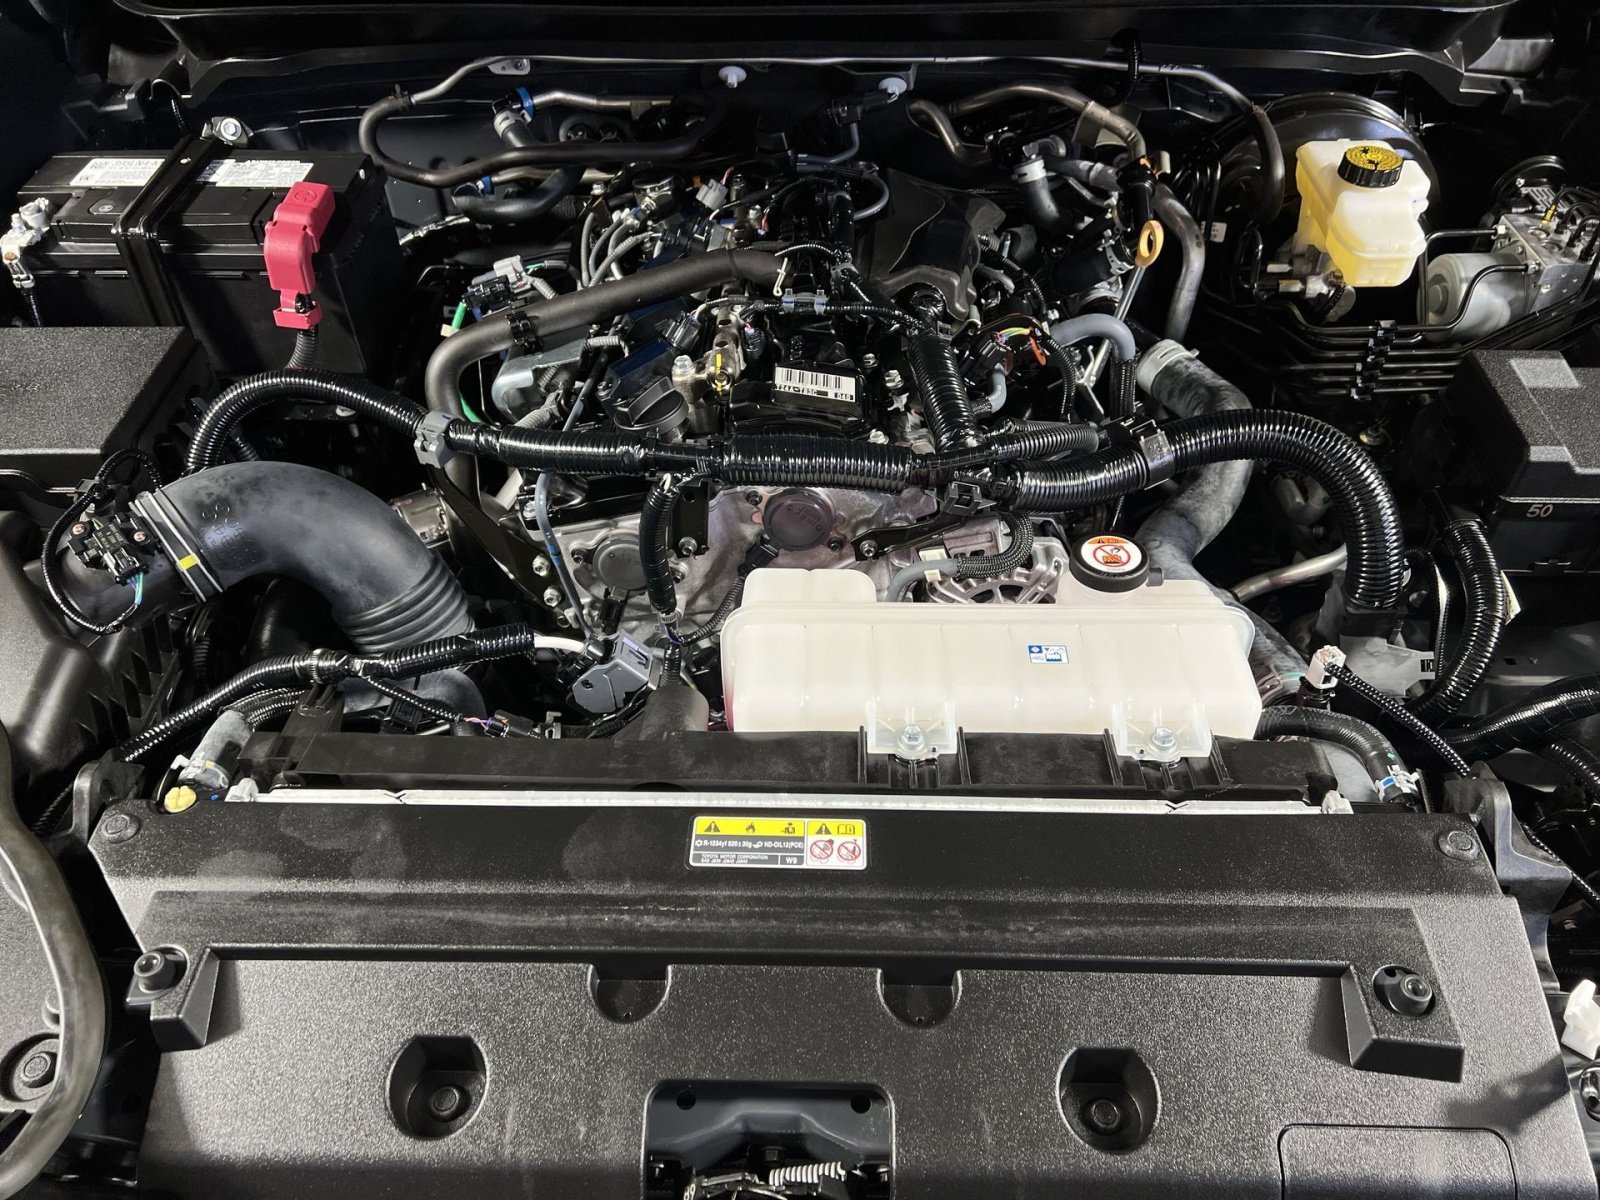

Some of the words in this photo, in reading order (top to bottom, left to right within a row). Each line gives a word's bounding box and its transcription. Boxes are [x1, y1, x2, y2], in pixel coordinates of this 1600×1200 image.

[1526, 503, 1554, 518] 50
[703, 840, 727, 848] R-1234yf
[785, 856, 797, 864] W9
